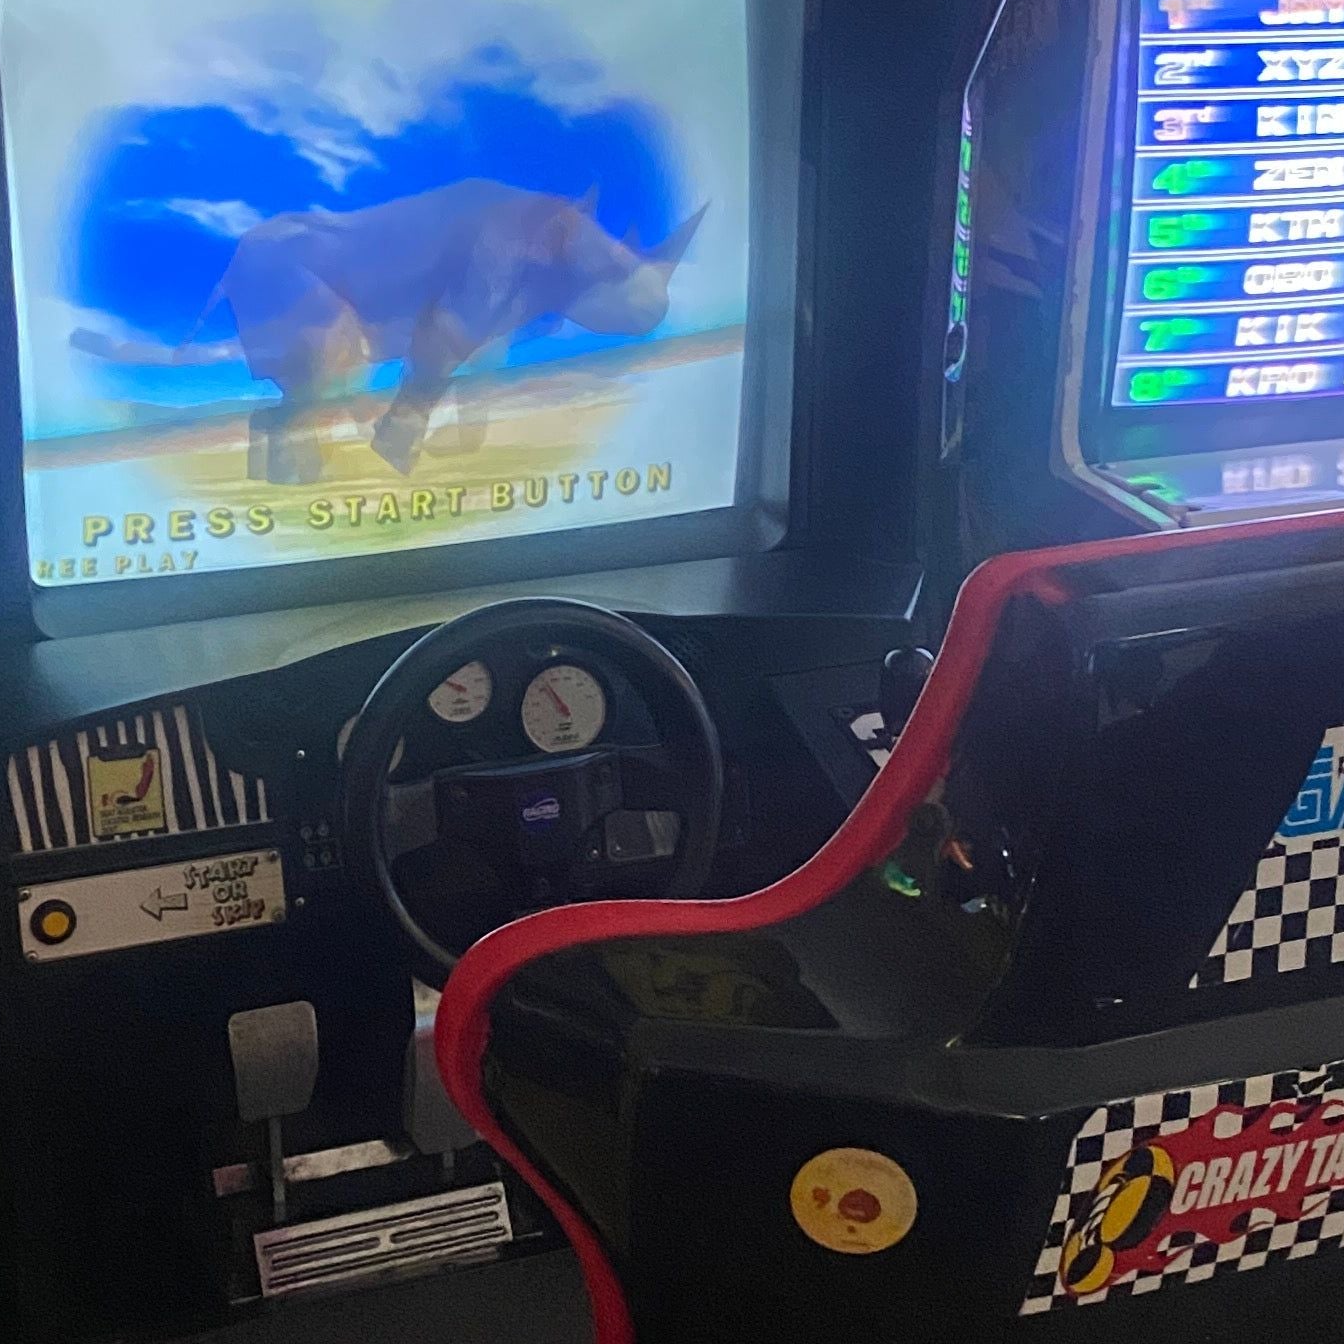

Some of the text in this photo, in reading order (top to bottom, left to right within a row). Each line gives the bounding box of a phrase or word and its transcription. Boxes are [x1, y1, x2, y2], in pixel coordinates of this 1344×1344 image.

[81, 461, 675, 547] PRESS START BUTTON
[114, 549, 200, 574] PLAY
[182, 856, 259, 890] START
[212, 880, 249, 904] OR
[1169, 1139, 1309, 1215] CRAZY
